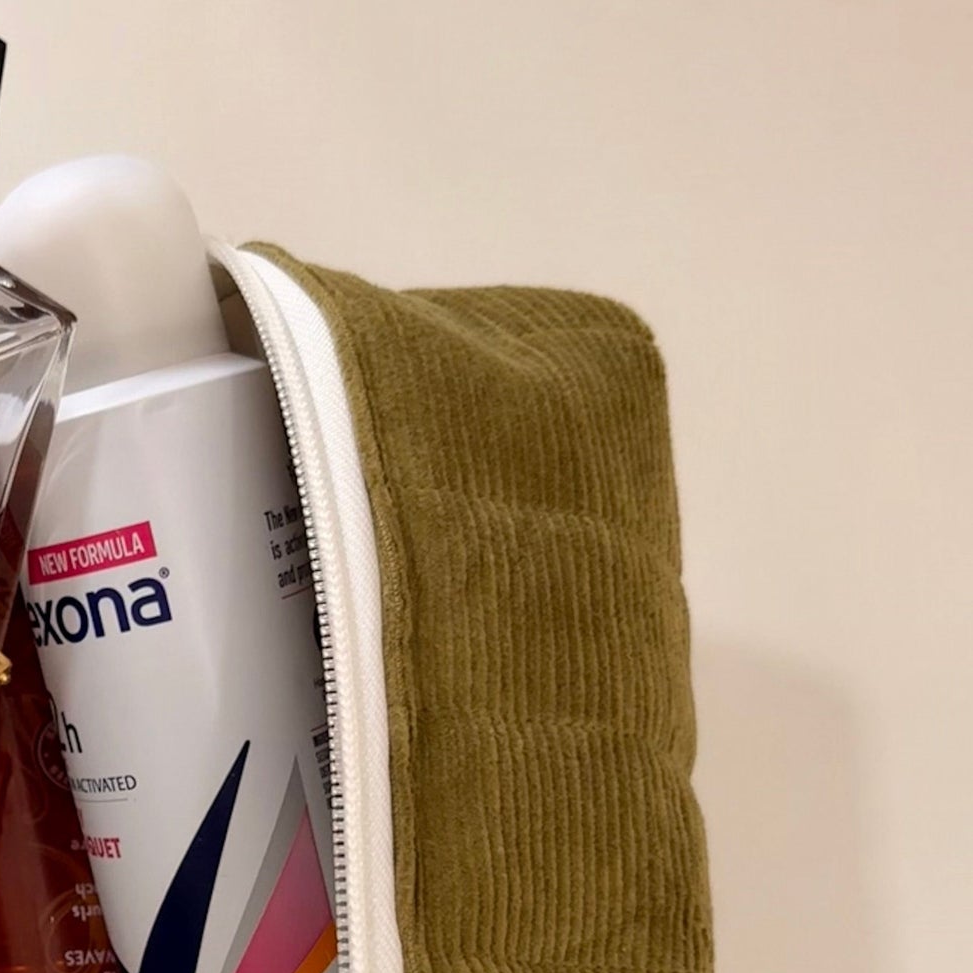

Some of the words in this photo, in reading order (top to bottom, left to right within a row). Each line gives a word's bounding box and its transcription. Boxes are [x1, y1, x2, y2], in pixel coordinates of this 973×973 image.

[264, 509, 285, 531] The
[40, 552, 68, 576] NEW
[69, 531, 146, 571] FORMULA
[270, 541, 282, 561] is
[26, 577, 173, 648] exona
[87, 836, 122, 859] QUET
[71, 904, 102, 922] urls
